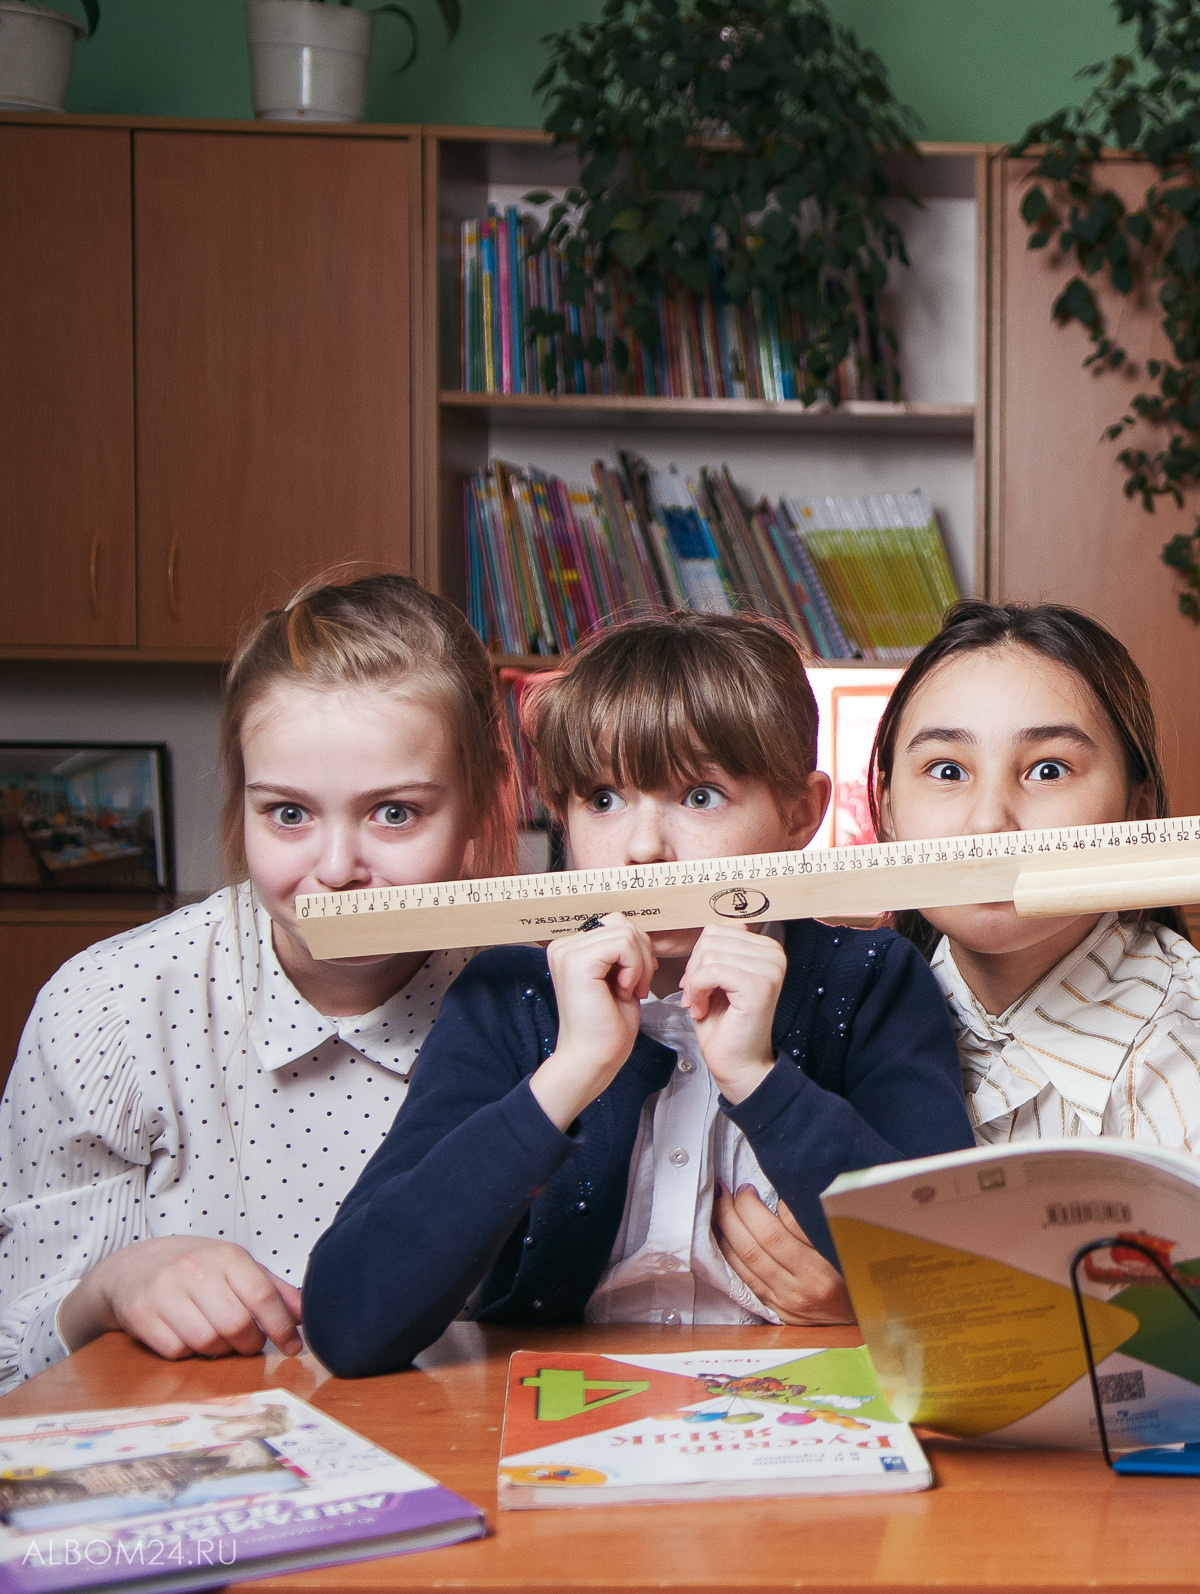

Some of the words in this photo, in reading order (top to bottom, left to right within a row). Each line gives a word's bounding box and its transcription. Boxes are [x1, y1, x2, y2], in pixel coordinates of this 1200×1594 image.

[301, 906, 309, 918] 0
[321, 908, 325, 916] 1
[336, 906, 341, 915] 2
[352, 904, 358, 913] 3
[368, 903, 374, 911] 4
[383, 901, 389, 910] 5
[399, 900, 406, 909] 6
[416, 899, 422, 907] 7
[433, 897, 440, 906] 8
[448, 895, 454, 905] 9
[466, 892, 480, 903] 10
[484, 892, 493, 900] 11
[501, 891, 511, 900] 12
[518, 890, 528, 899] 13
[534, 889, 545, 897] 14
[550, 887, 561, 896] 15
[567, 885, 578, 894] 16
[583, 884, 594, 893] 17
[600, 882, 611, 891] 18
[617, 881, 628, 890] 19
[630, 878, 645, 889] 20
[648, 878, 659, 887] 21
[665, 877, 677, 886] 22
[681, 875, 694, 884] 23
[698, 874, 710, 882] 24
[715, 872, 727, 881] 25
[732, 870, 744, 879] 26
[749, 869, 760, 878] 27
[765, 868, 777, 877] 28
[782, 866, 794, 875] 29
[798, 863, 812, 874] 30
[815, 863, 827, 872] 31
[832, 861, 845, 870] 32
[850, 860, 862, 869] 33
[867, 858, 879, 867] 34
[884, 857, 896, 866] 35
[901, 855, 913, 864] 36
[918, 853, 930, 863] 37
[935, 852, 948, 861] 38
[952, 851, 965, 860] 39
[968, 847, 983, 858] 40
[986, 848, 998, 857] 41
[1003, 847, 1016, 856] 42
[1021, 845, 1033, 854] 43
[1038, 843, 1051, 852] 44
[1055, 842, 1068, 851] 45
[1073, 840, 1085, 849] 46
[1090, 839, 1102, 848] 47
[1108, 837, 1121, 846] 48
[1125, 836, 1138, 845] 49
[1141, 833, 1156, 844] 50
[1159, 833, 1171, 842] 51
[1176, 832, 1190, 841] 52
[520, 1368, 650, 1422] 4
[679, 1433, 896, 1456] Русский
